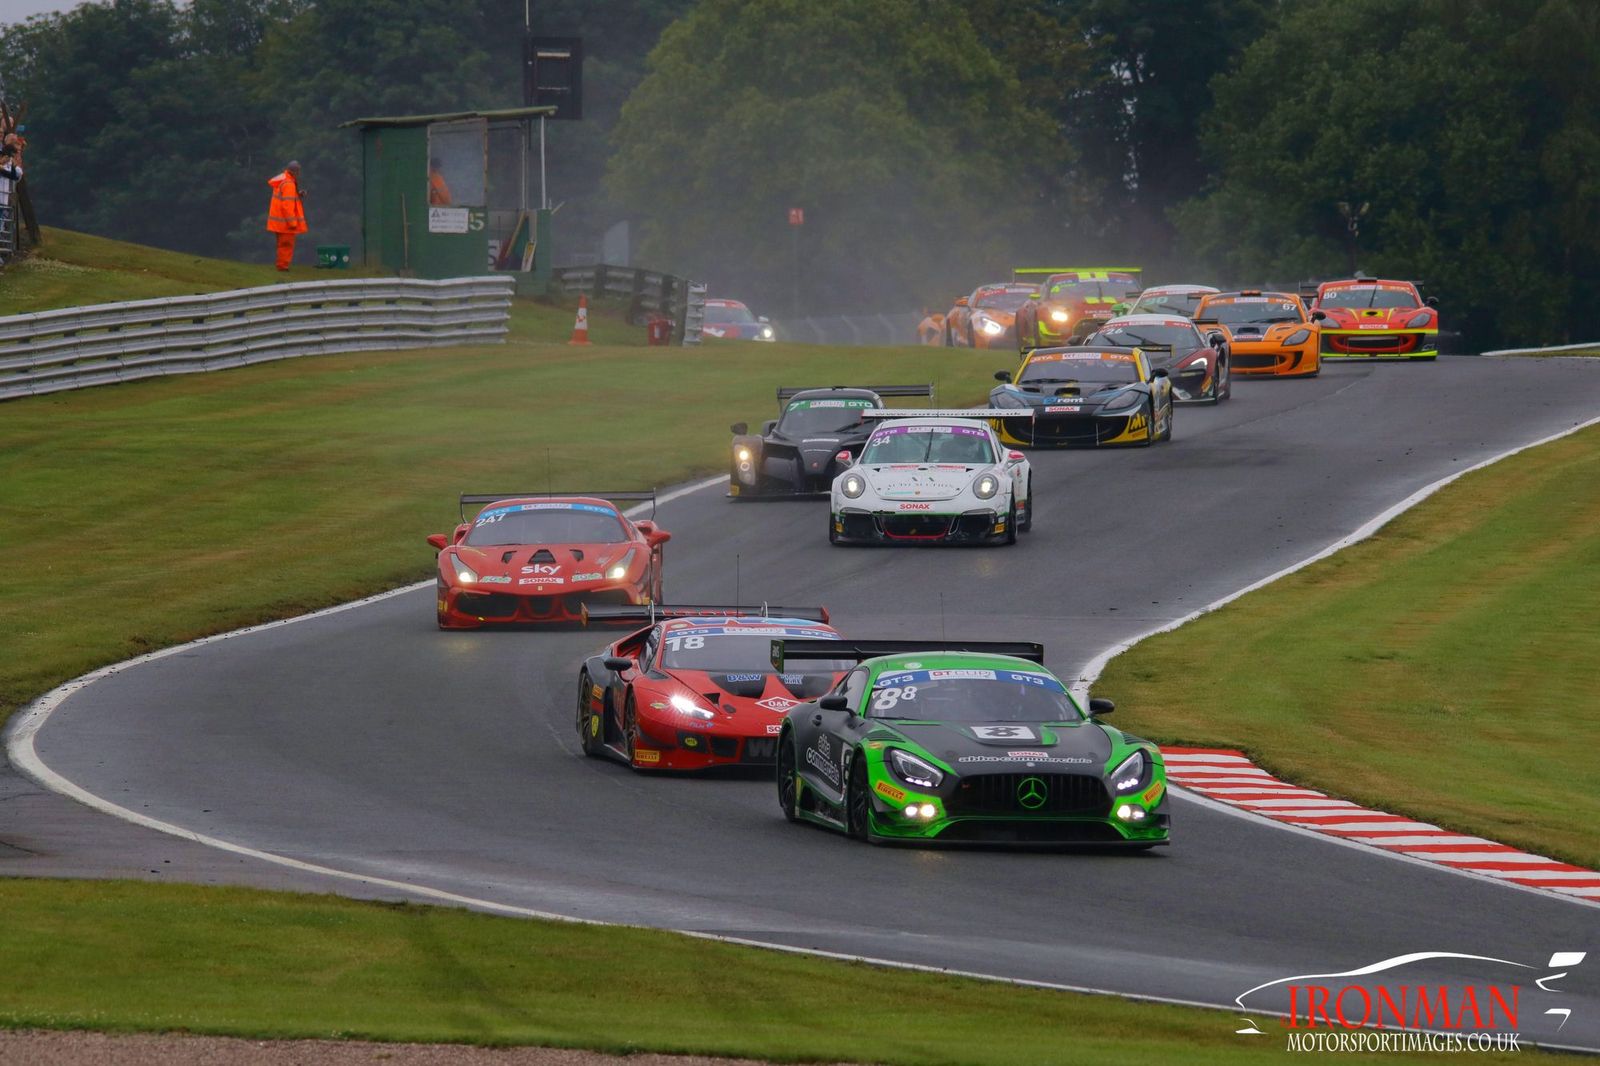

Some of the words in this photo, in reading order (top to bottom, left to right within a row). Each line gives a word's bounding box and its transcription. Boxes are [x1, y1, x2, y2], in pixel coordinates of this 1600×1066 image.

[872, 436, 891, 447] 34
[476, 513, 507, 527] 247
[521, 564, 561, 575] sky
[524, 576, 558, 584] SONAX
[665, 637, 705, 652] 18
[879, 674, 914, 687] GT3
[1011, 673, 1045, 685] GT3
